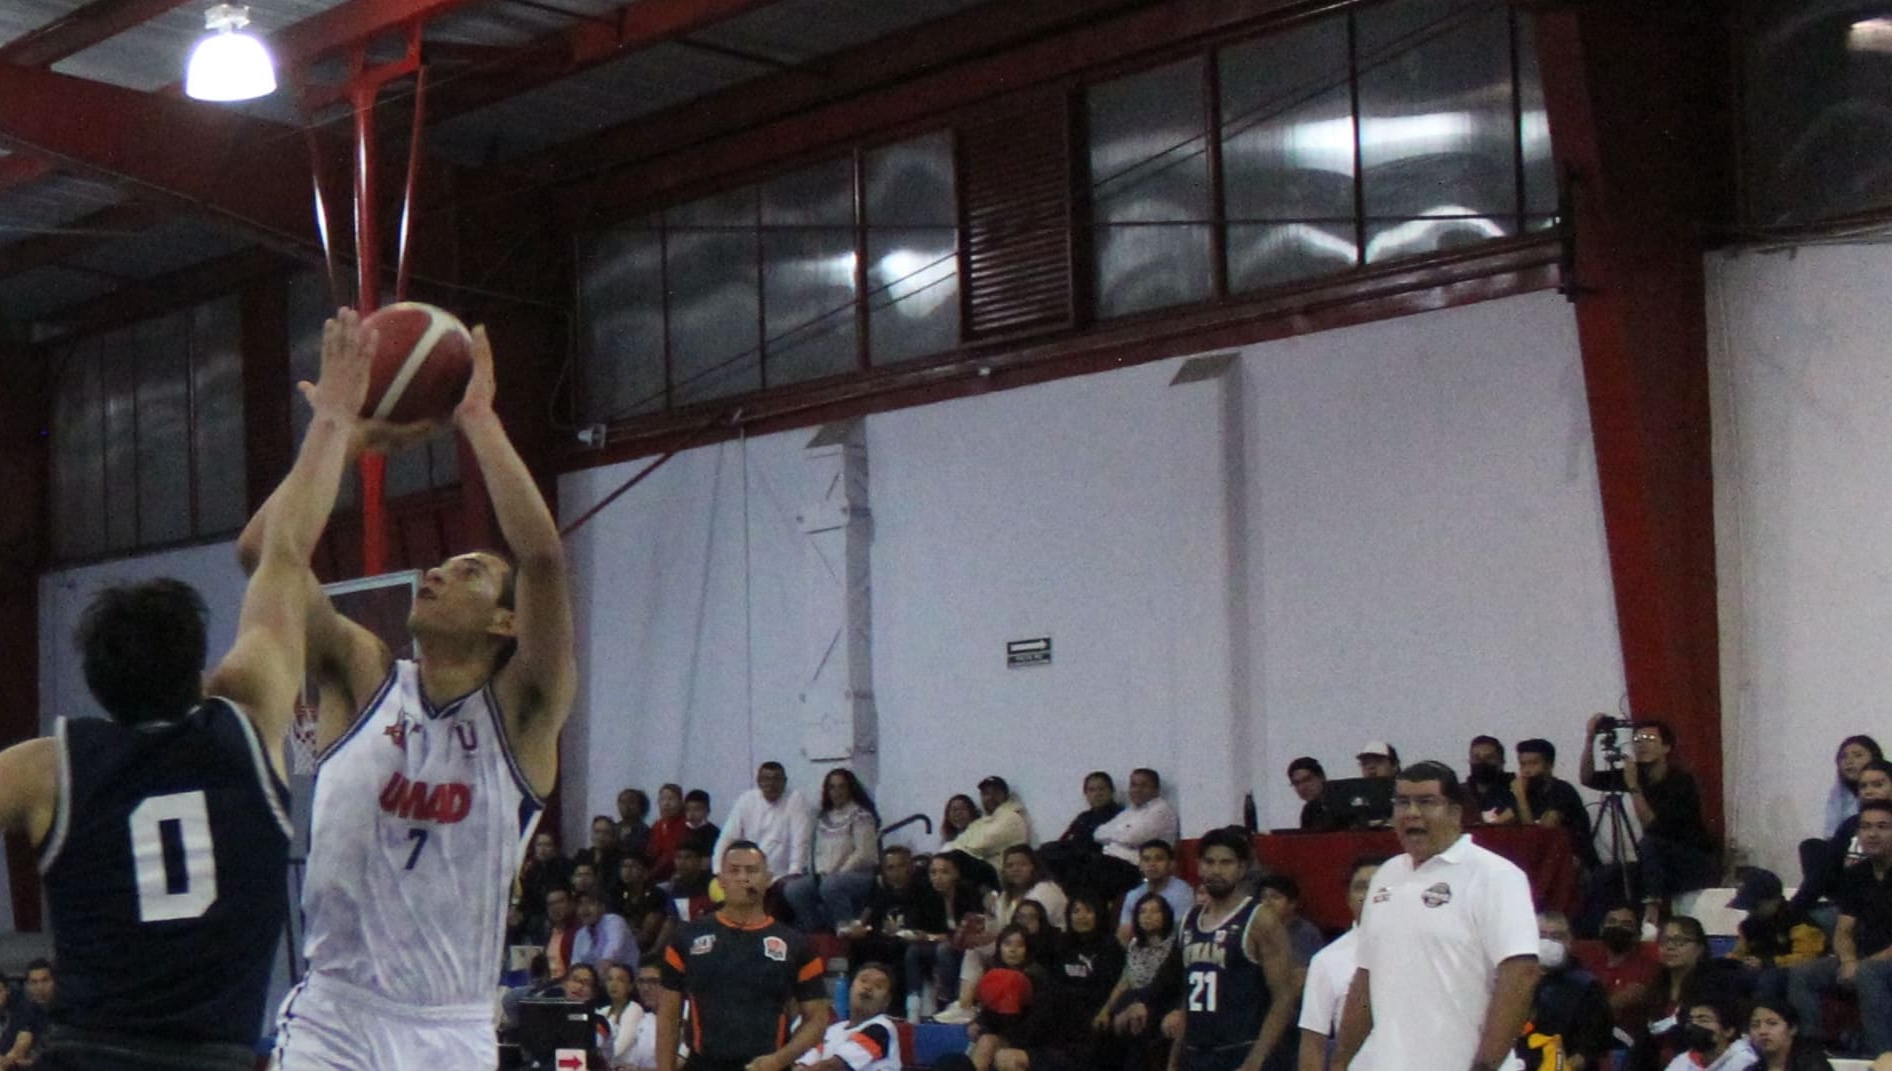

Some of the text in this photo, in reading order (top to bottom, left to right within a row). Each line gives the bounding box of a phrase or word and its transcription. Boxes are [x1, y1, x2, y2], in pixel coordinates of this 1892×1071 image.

[379, 771, 471, 824] UMAD
[129, 790, 218, 923] 0
[404, 828, 429, 870] 7
[1188, 971, 1218, 1012] 21
